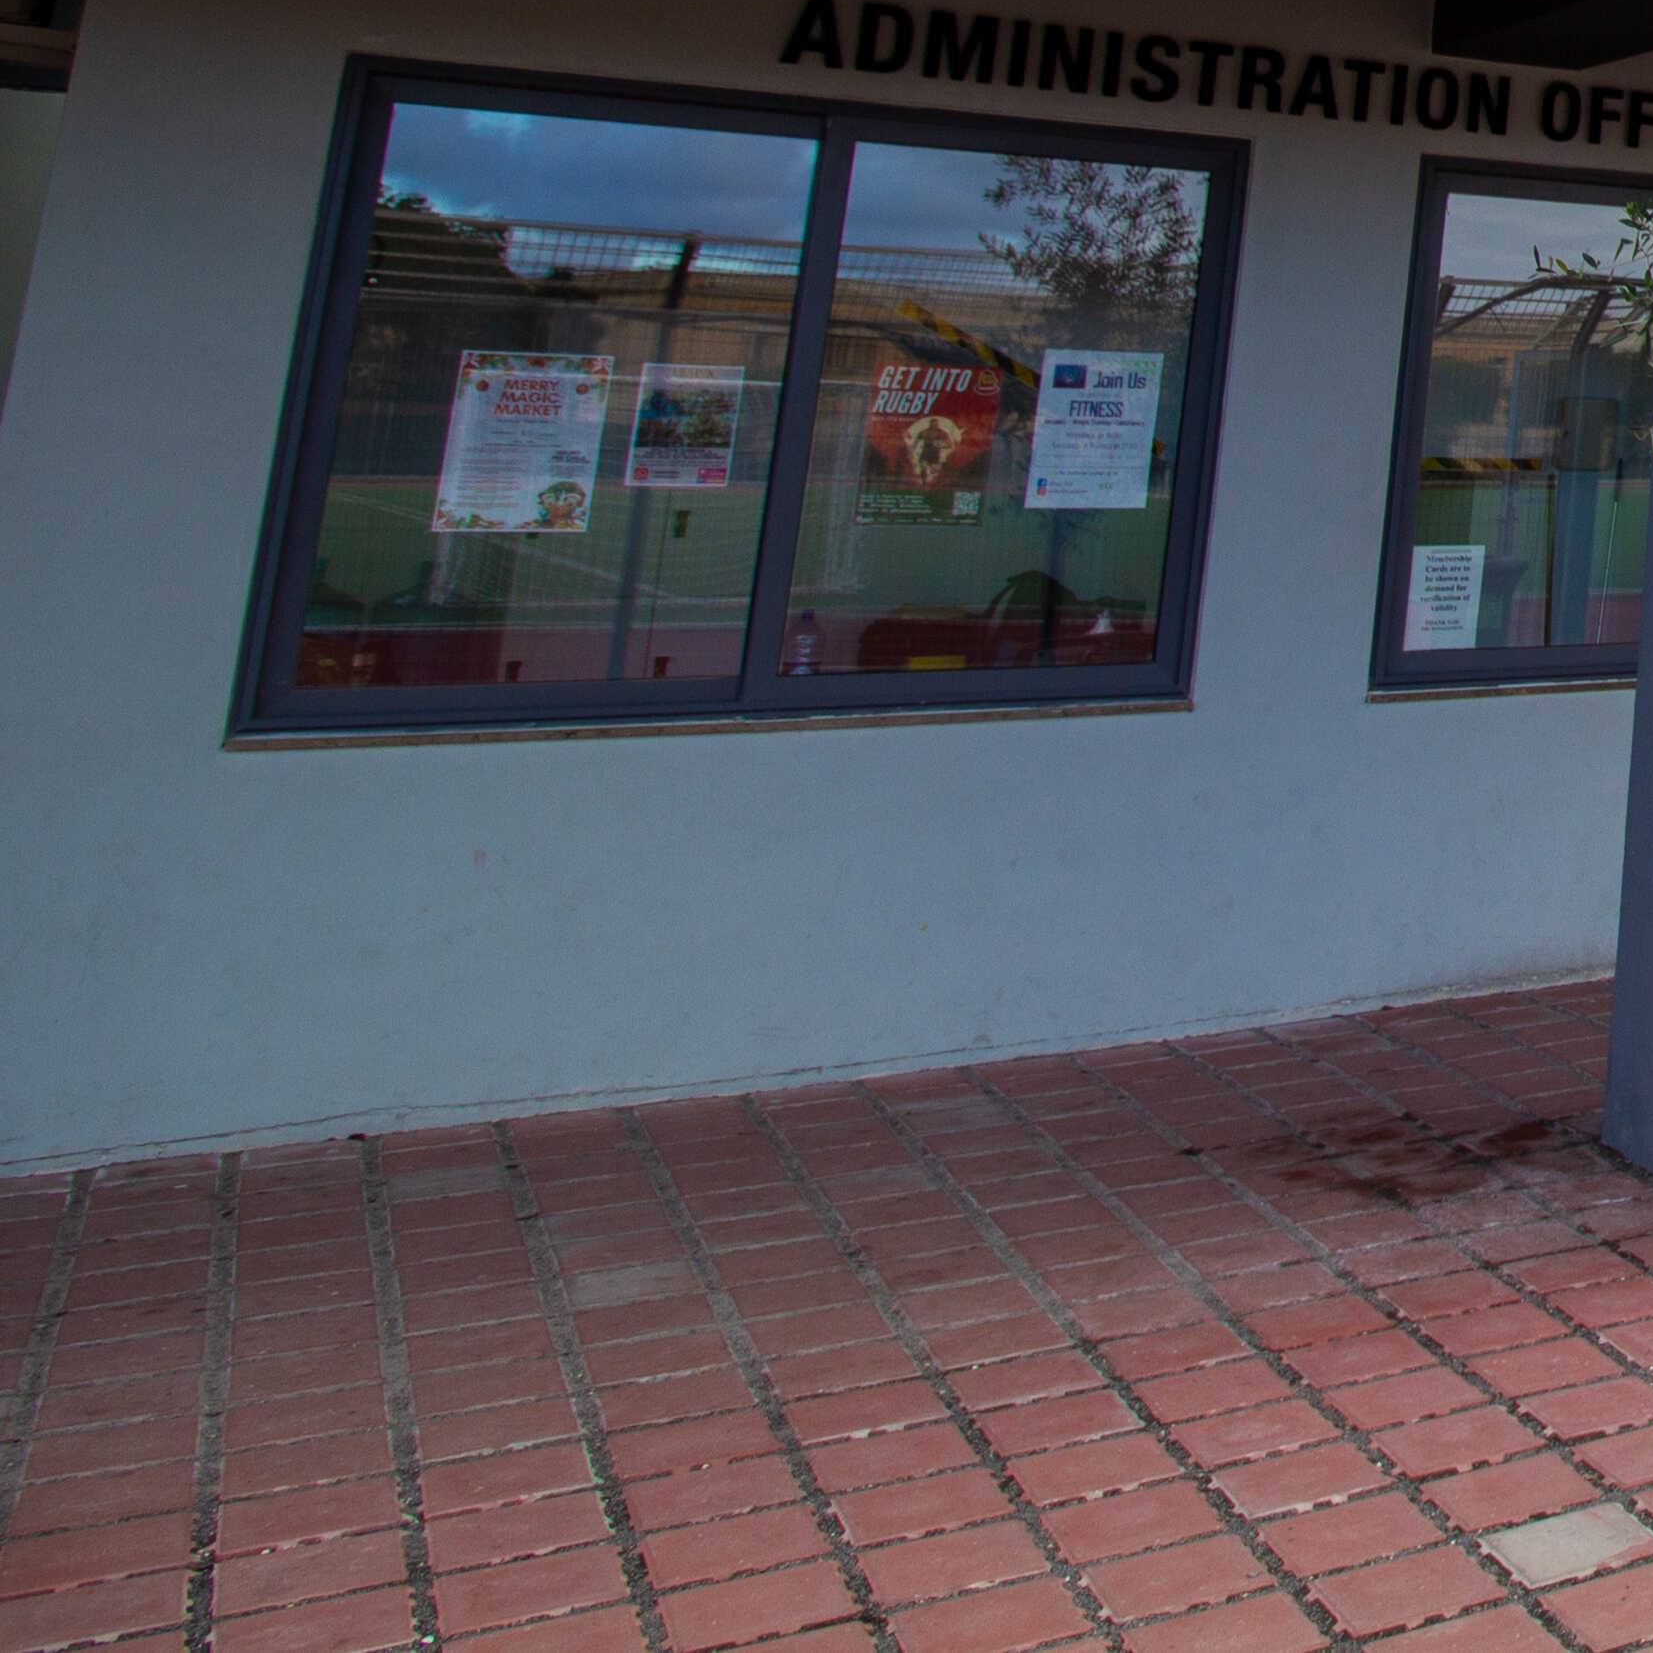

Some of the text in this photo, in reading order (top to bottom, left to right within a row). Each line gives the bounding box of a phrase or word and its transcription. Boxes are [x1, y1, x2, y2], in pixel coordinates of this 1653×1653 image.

[503, 379, 561, 391] MERRY
[877, 365, 973, 393] GET INTO
[1093, 371, 1147, 389] Join Us
[500, 391, 561, 404] MAGIC
[873, 389, 940, 415] RUGBY
[493, 404, 563, 416] MARKET
[1068, 400, 1125, 418] FITNESS
